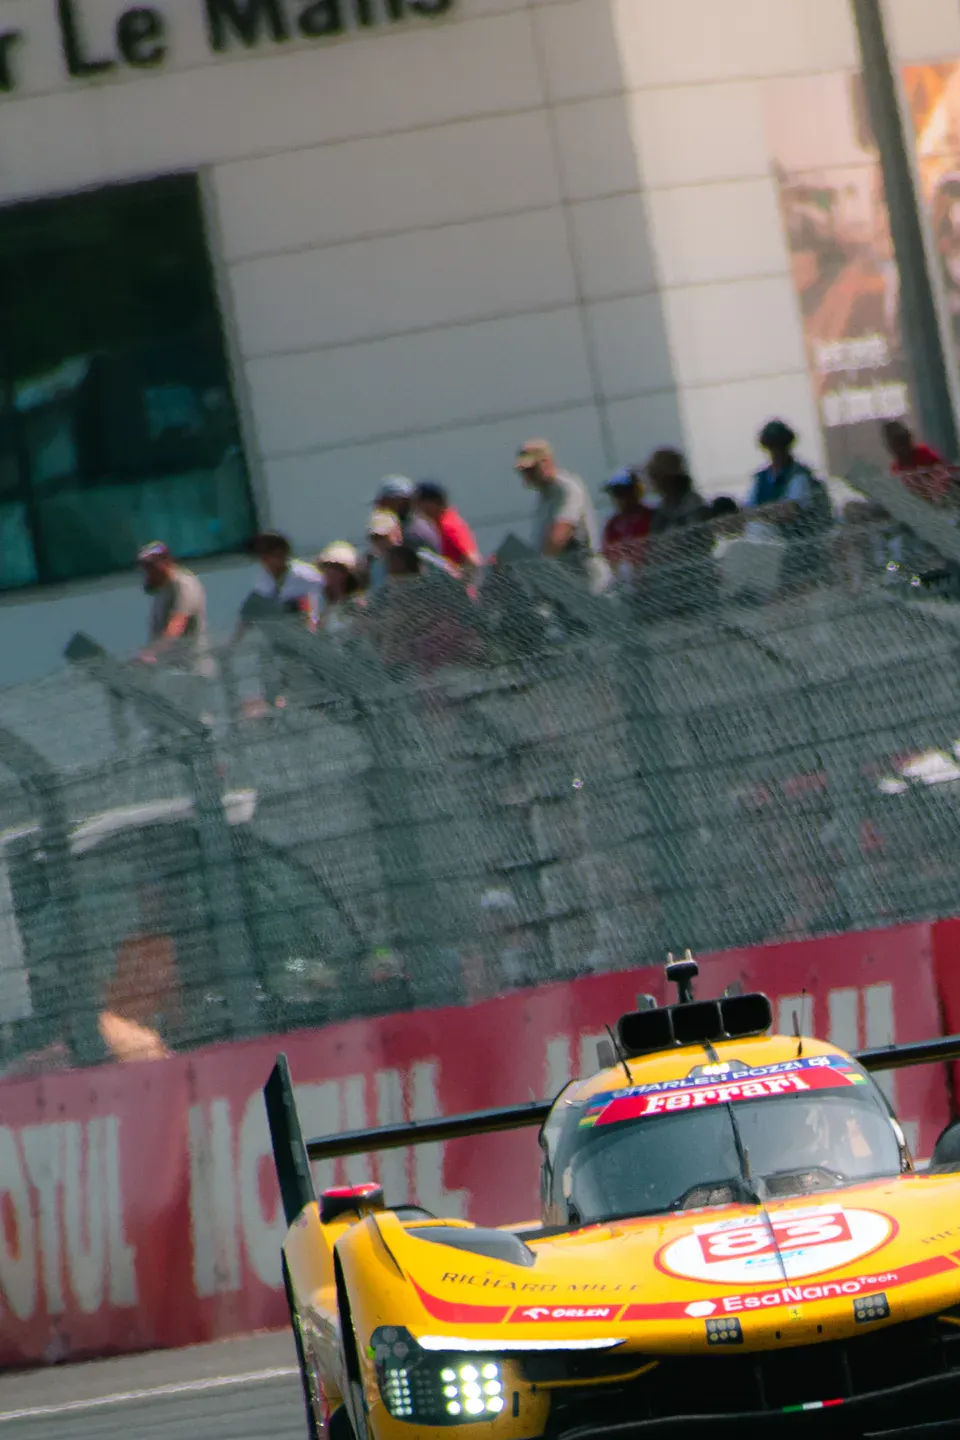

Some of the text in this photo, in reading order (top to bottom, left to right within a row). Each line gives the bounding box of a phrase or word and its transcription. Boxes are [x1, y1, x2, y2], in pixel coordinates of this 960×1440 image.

[56, 0, 168, 77] Le
[206, 0, 454, 53] Ma
[732, 1061, 804, 1079] POZZI
[640, 1073, 810, 1115] Ferrari
[708, 1215, 844, 1256] 83
[441, 1272, 643, 1292] RICHARD MILLE
[551, 1307, 611, 1318] ORLEN
